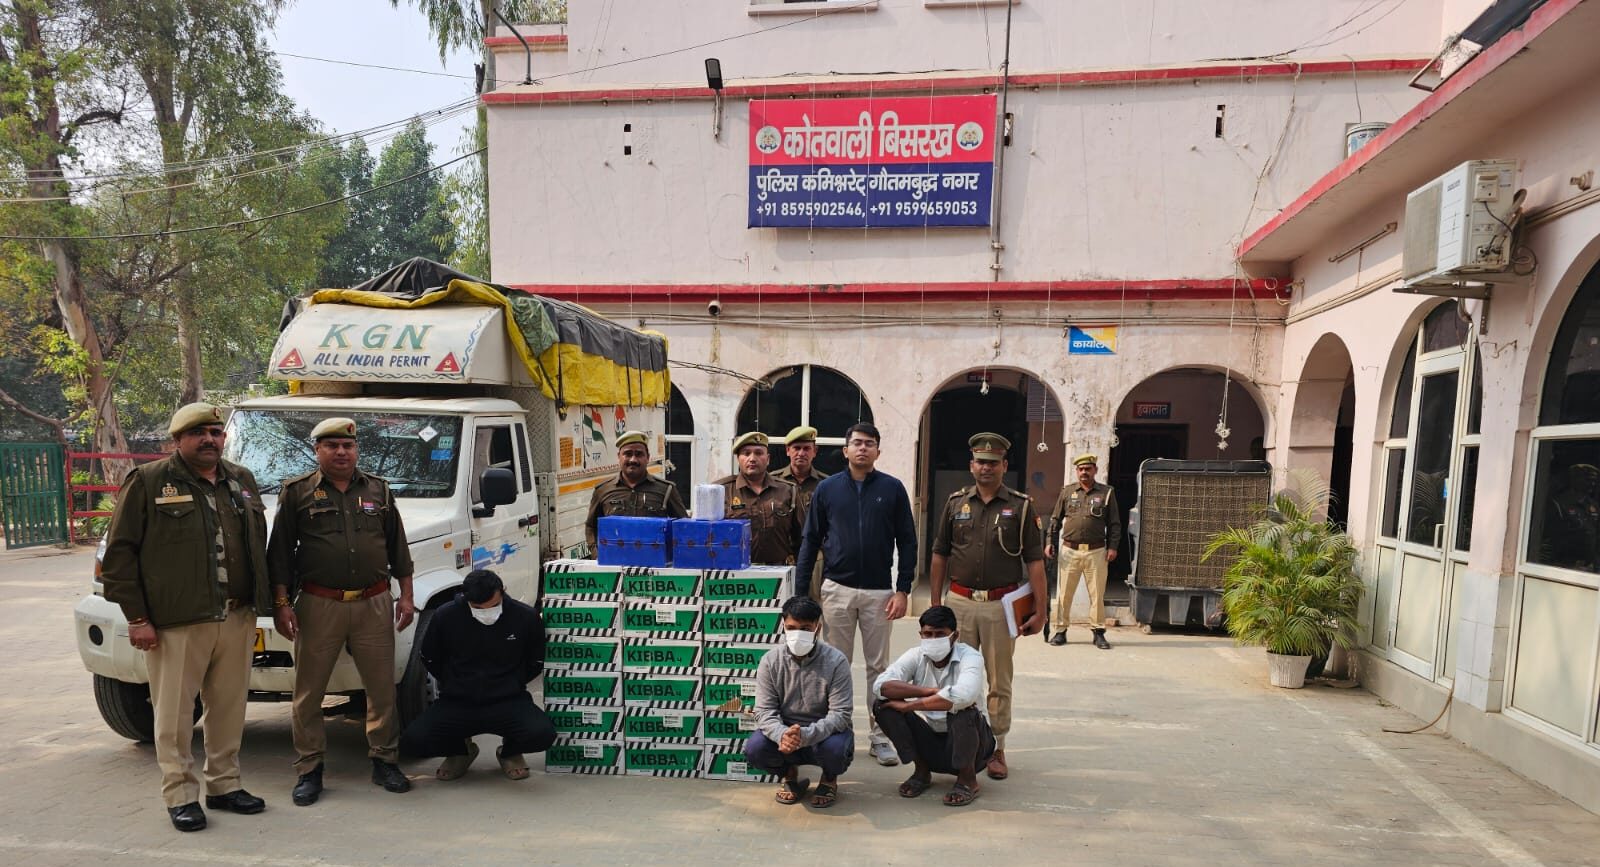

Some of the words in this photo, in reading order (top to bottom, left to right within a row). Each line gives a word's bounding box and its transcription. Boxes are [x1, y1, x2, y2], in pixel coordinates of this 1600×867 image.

[783, 111, 874, 160] कोतवाली
[878, 110, 955, 158] बिसरख
[756, 168, 797, 201] पुलिस
[868, 166, 939, 200] गौतमबुद्ध
[942, 173, 979, 191] नगर
[756, 203, 777, 217] +91
[781, 202, 866, 218] 8595902546,
[869, 201, 891, 216] +91
[895, 201, 977, 216] 9599659053
[313, 352, 340, 366] ALL
[346, 353, 385, 368] INDIA
[389, 354, 431, 368] PERMIT
[1136, 404, 1168, 417] हवालात
[549, 577, 597, 590] KIBBA
[628, 580, 676, 593] KIBBA
[708, 583, 758, 596] KIBBA
[546, 612, 594, 624] KIBBA
[709, 617, 758, 631] KIBBA
[547, 646, 595, 659] KIBBA
[627, 650, 675, 663] KIBBA
[707, 652, 757, 665] KIBBA
[547, 681, 595, 694] KIBBA
[627, 684, 675, 697] KIBBA
[630, 753, 679, 766] KIBBA
